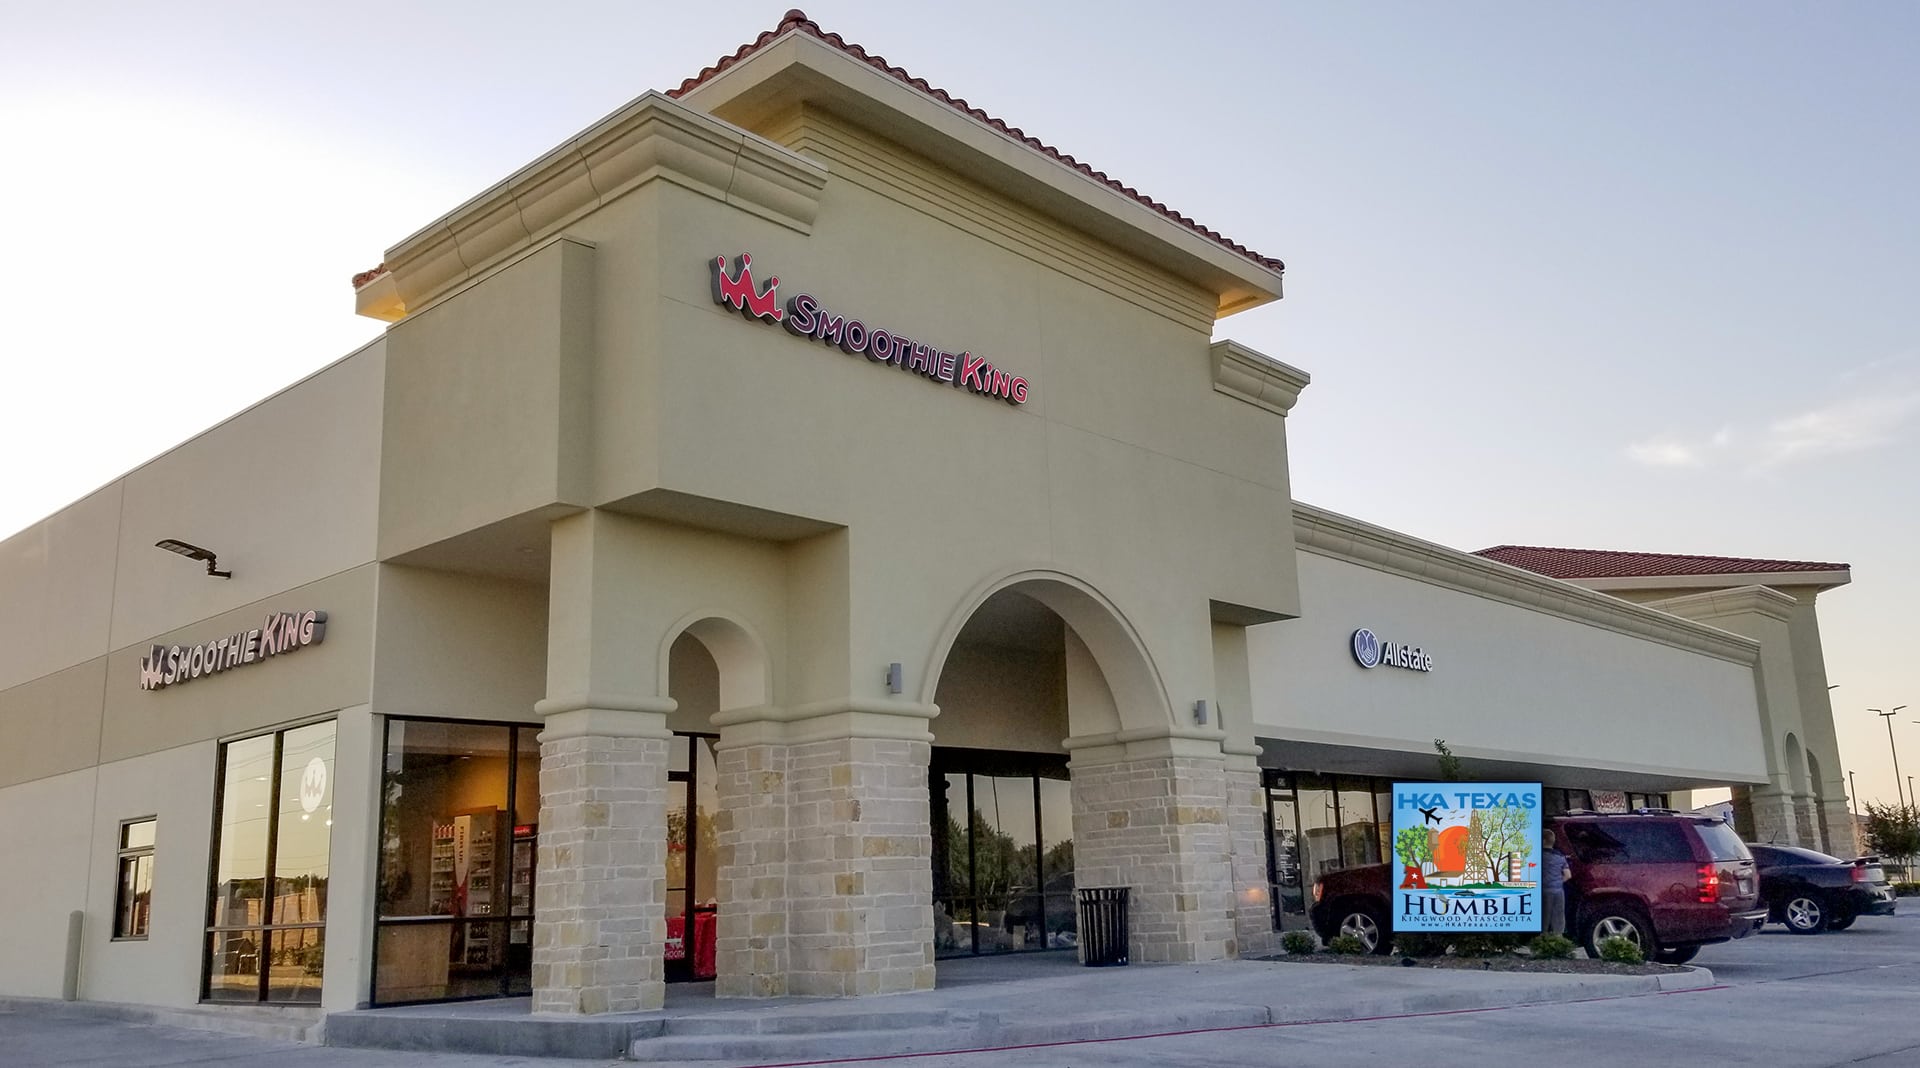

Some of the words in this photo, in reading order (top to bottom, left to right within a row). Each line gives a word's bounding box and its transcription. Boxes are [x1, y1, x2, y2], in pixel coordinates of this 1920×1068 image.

[788, 293, 956, 382] SMOOTHIE
[164, 629, 259, 685] SMOOTHIE
[1382, 641, 1433, 672] Allstate
